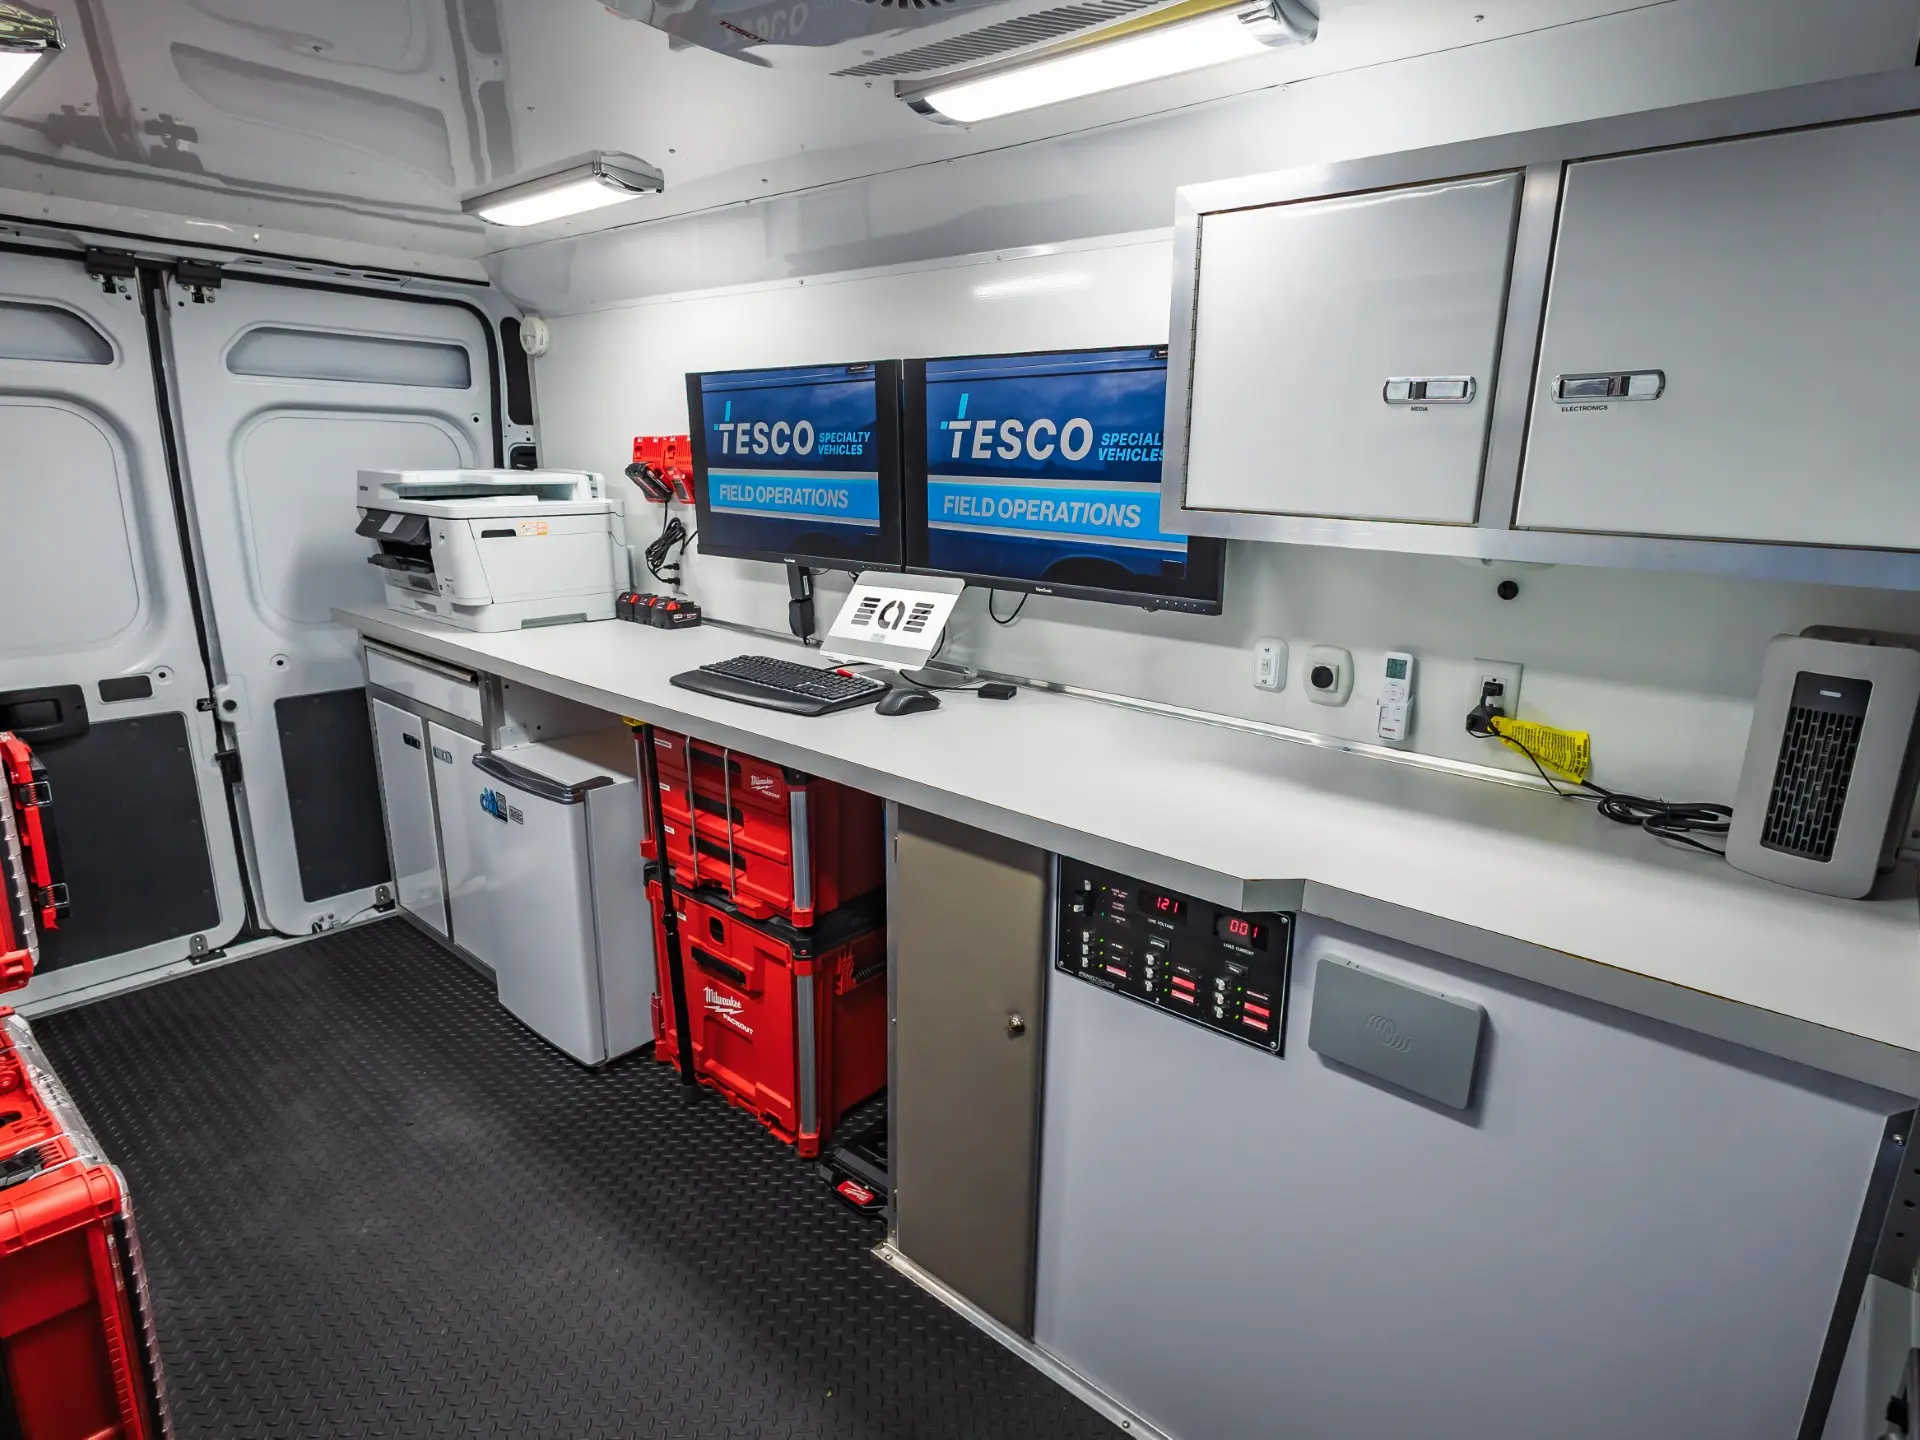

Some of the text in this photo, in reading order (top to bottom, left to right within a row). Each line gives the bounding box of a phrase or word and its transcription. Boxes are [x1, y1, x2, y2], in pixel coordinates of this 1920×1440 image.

[719, 19, 769, 43] TOSOT
[1560, 404, 1608, 413] ELECTRONICS
[717, 419, 815, 456] TESCO
[818, 431, 871, 443] SPECIALTY
[946, 417, 1094, 461] TESCO
[1101, 432, 1163, 446] SPECIAL
[818, 444, 863, 456] VEHICLES
[719, 483, 849, 509] FIELD OPERATIONS
[943, 495, 1142, 528] FIELD OPERATIONS
[1156, 896, 1179, 914] 121
[1229, 919, 1259, 939] 001
[703, 986, 742, 1009] Milwaukee
[722, 1013, 754, 1035] PACKOUT
